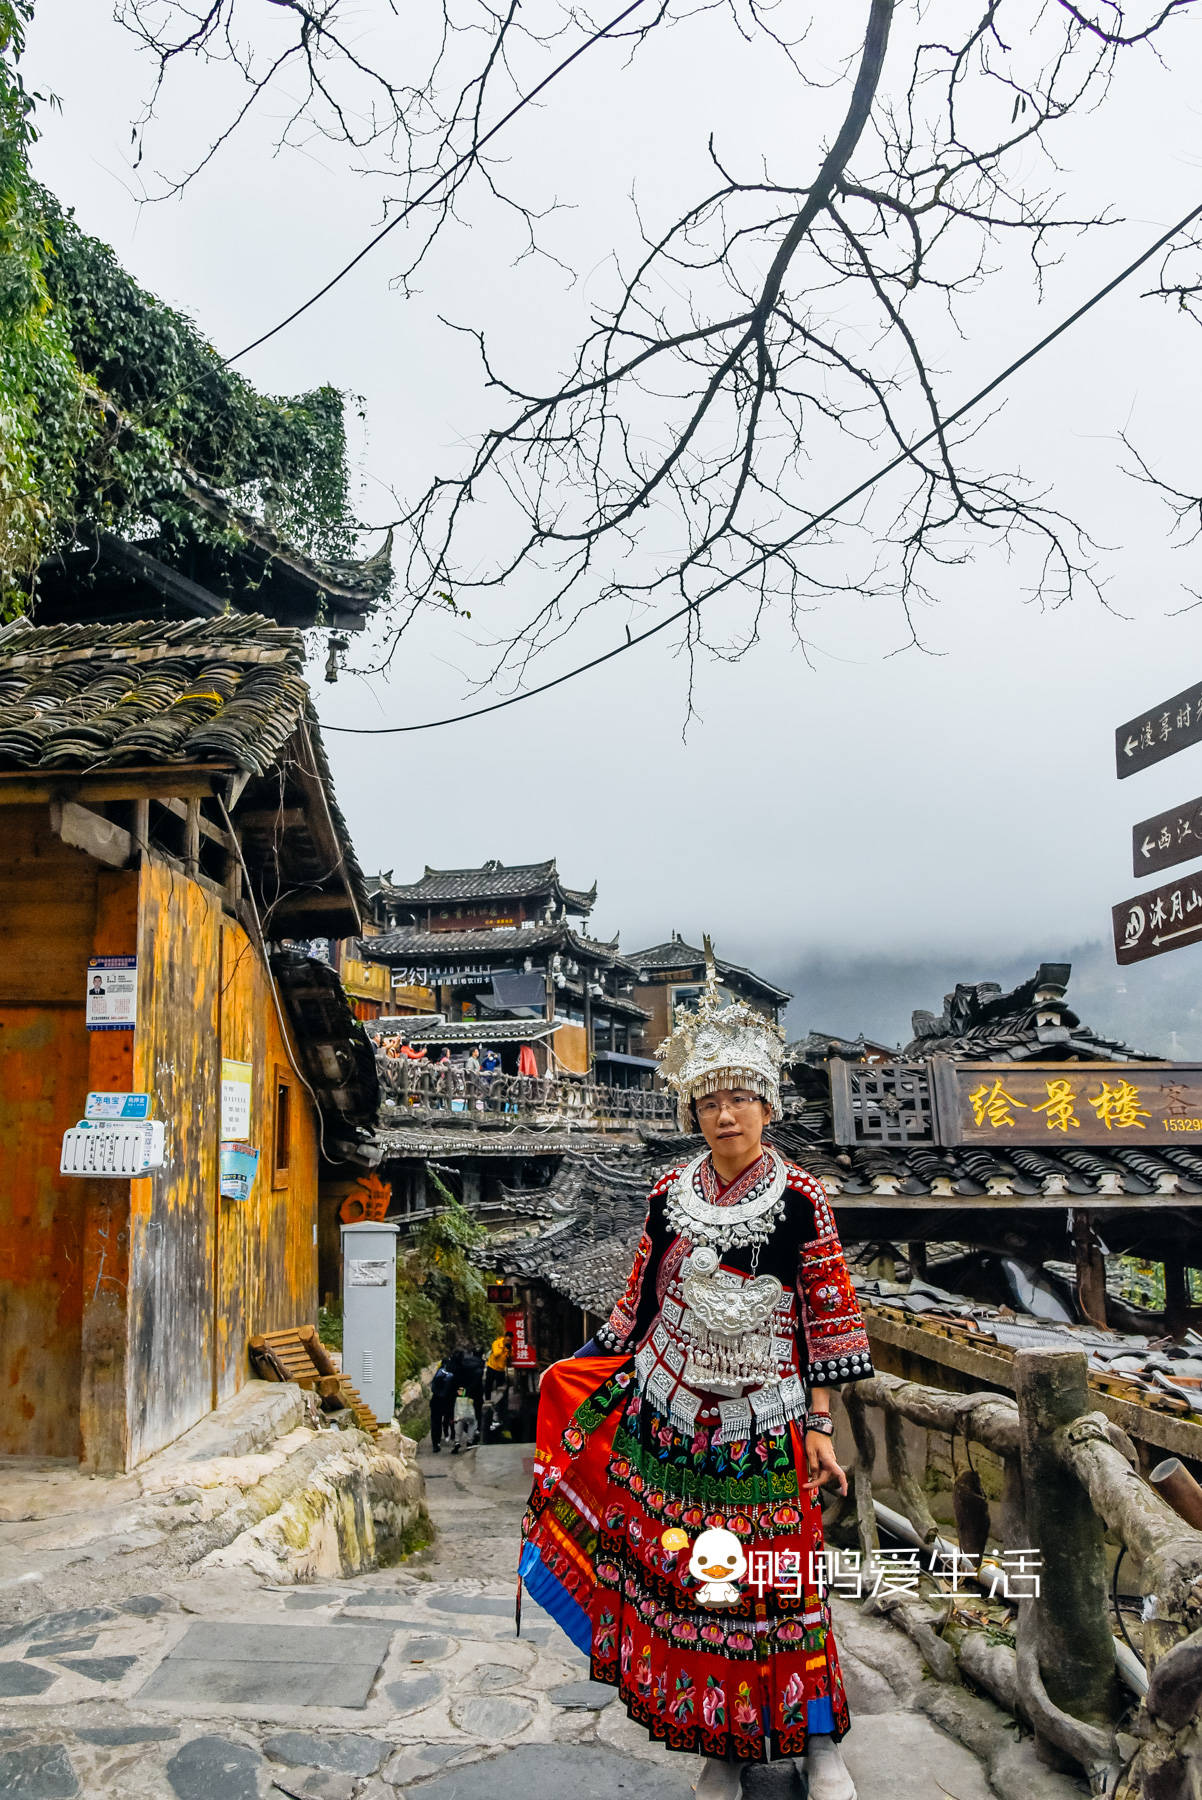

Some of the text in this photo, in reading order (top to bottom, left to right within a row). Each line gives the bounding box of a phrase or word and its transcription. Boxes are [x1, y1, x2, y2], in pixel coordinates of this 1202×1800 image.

[429, 964, 491, 976] ENJOY MEET
[95, 1096, 120, 1105] 充电宝
[968, 1078, 1152, 1132] 绘景楼
[1162, 1118, 1202, 1132] 15329
